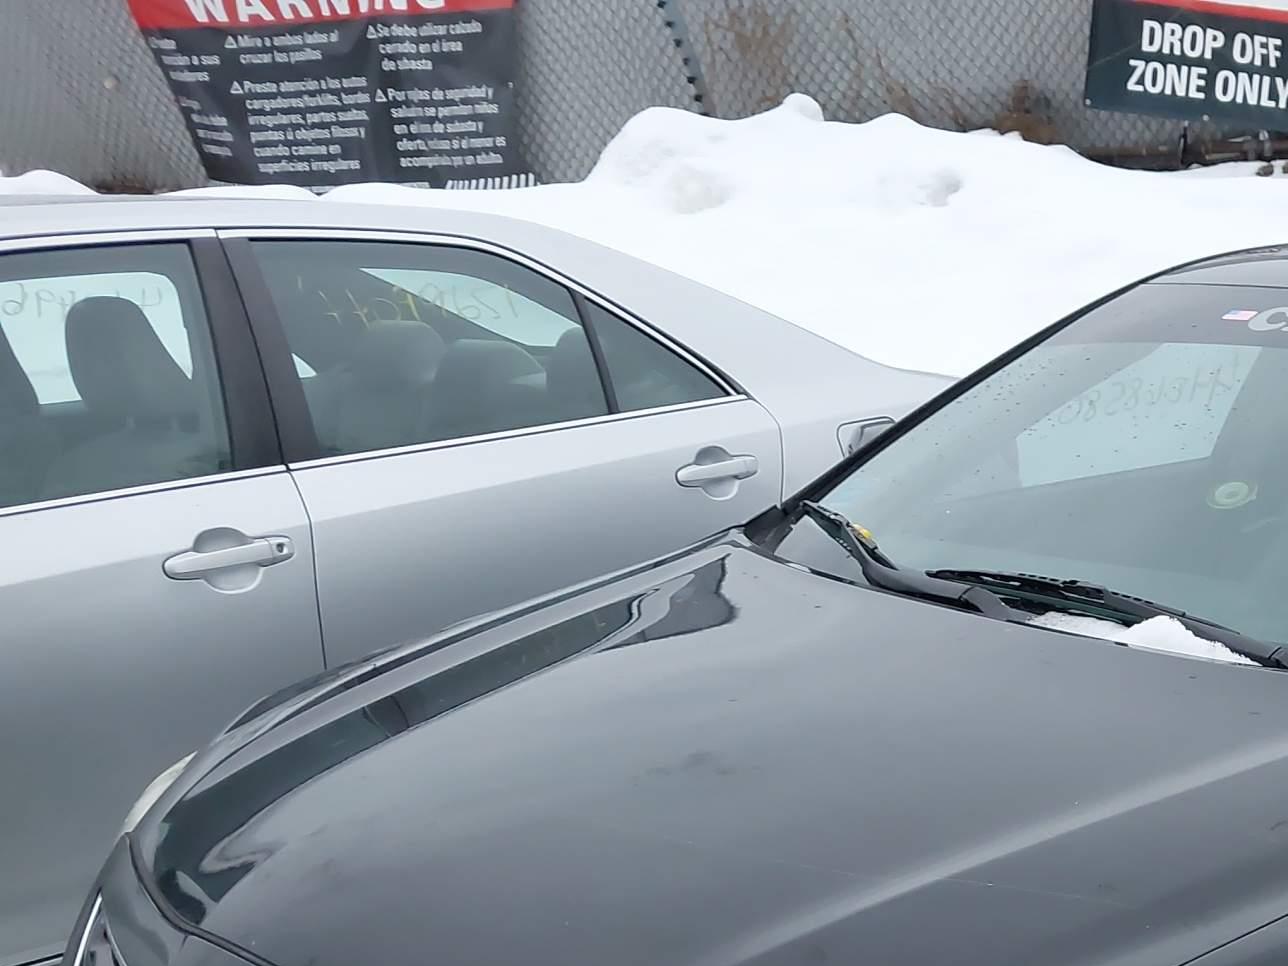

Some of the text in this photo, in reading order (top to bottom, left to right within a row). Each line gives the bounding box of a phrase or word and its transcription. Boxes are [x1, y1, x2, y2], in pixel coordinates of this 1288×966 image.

[184, 0, 446, 22] WARN
[1141, 20, 1282, 67] DROP OFF
[1126, 59, 1207, 99] ZONE
